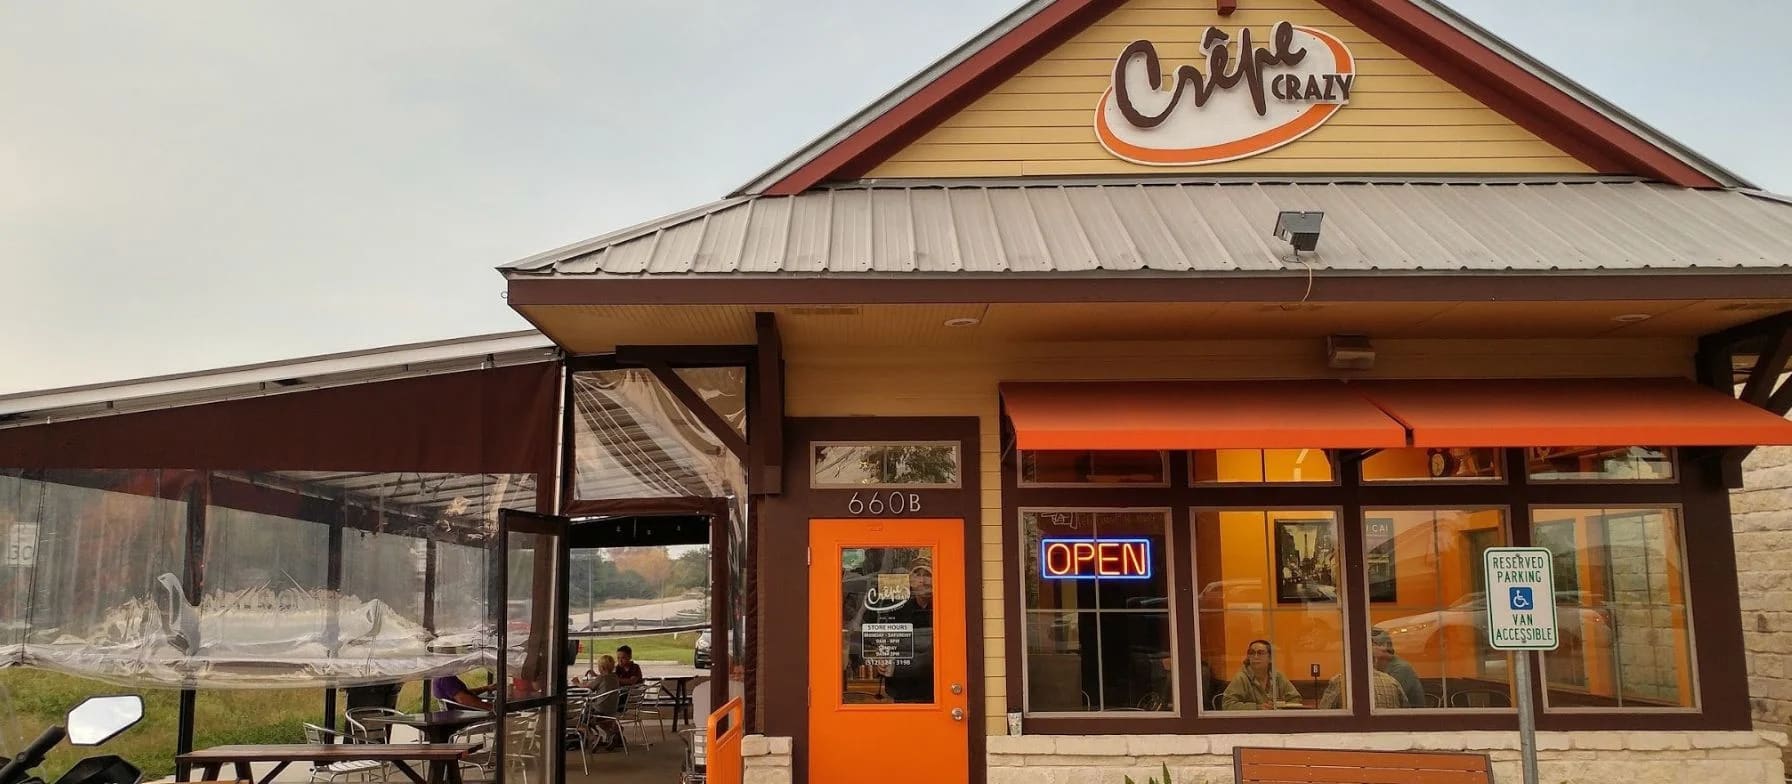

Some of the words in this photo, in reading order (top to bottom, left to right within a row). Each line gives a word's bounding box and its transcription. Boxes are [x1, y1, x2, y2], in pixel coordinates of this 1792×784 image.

[1115, 21, 1307, 129] Crêpe
[1271, 73, 1353, 101] CRAZY
[848, 491, 921, 514] 660B
[1047, 543, 1146, 576] OPEN
[1492, 556, 1545, 570] RESERVED
[1497, 570, 1543, 583] PARKING
[1512, 613, 1534, 626] VAN
[1495, 627, 1553, 641] ACCESSIBLE
